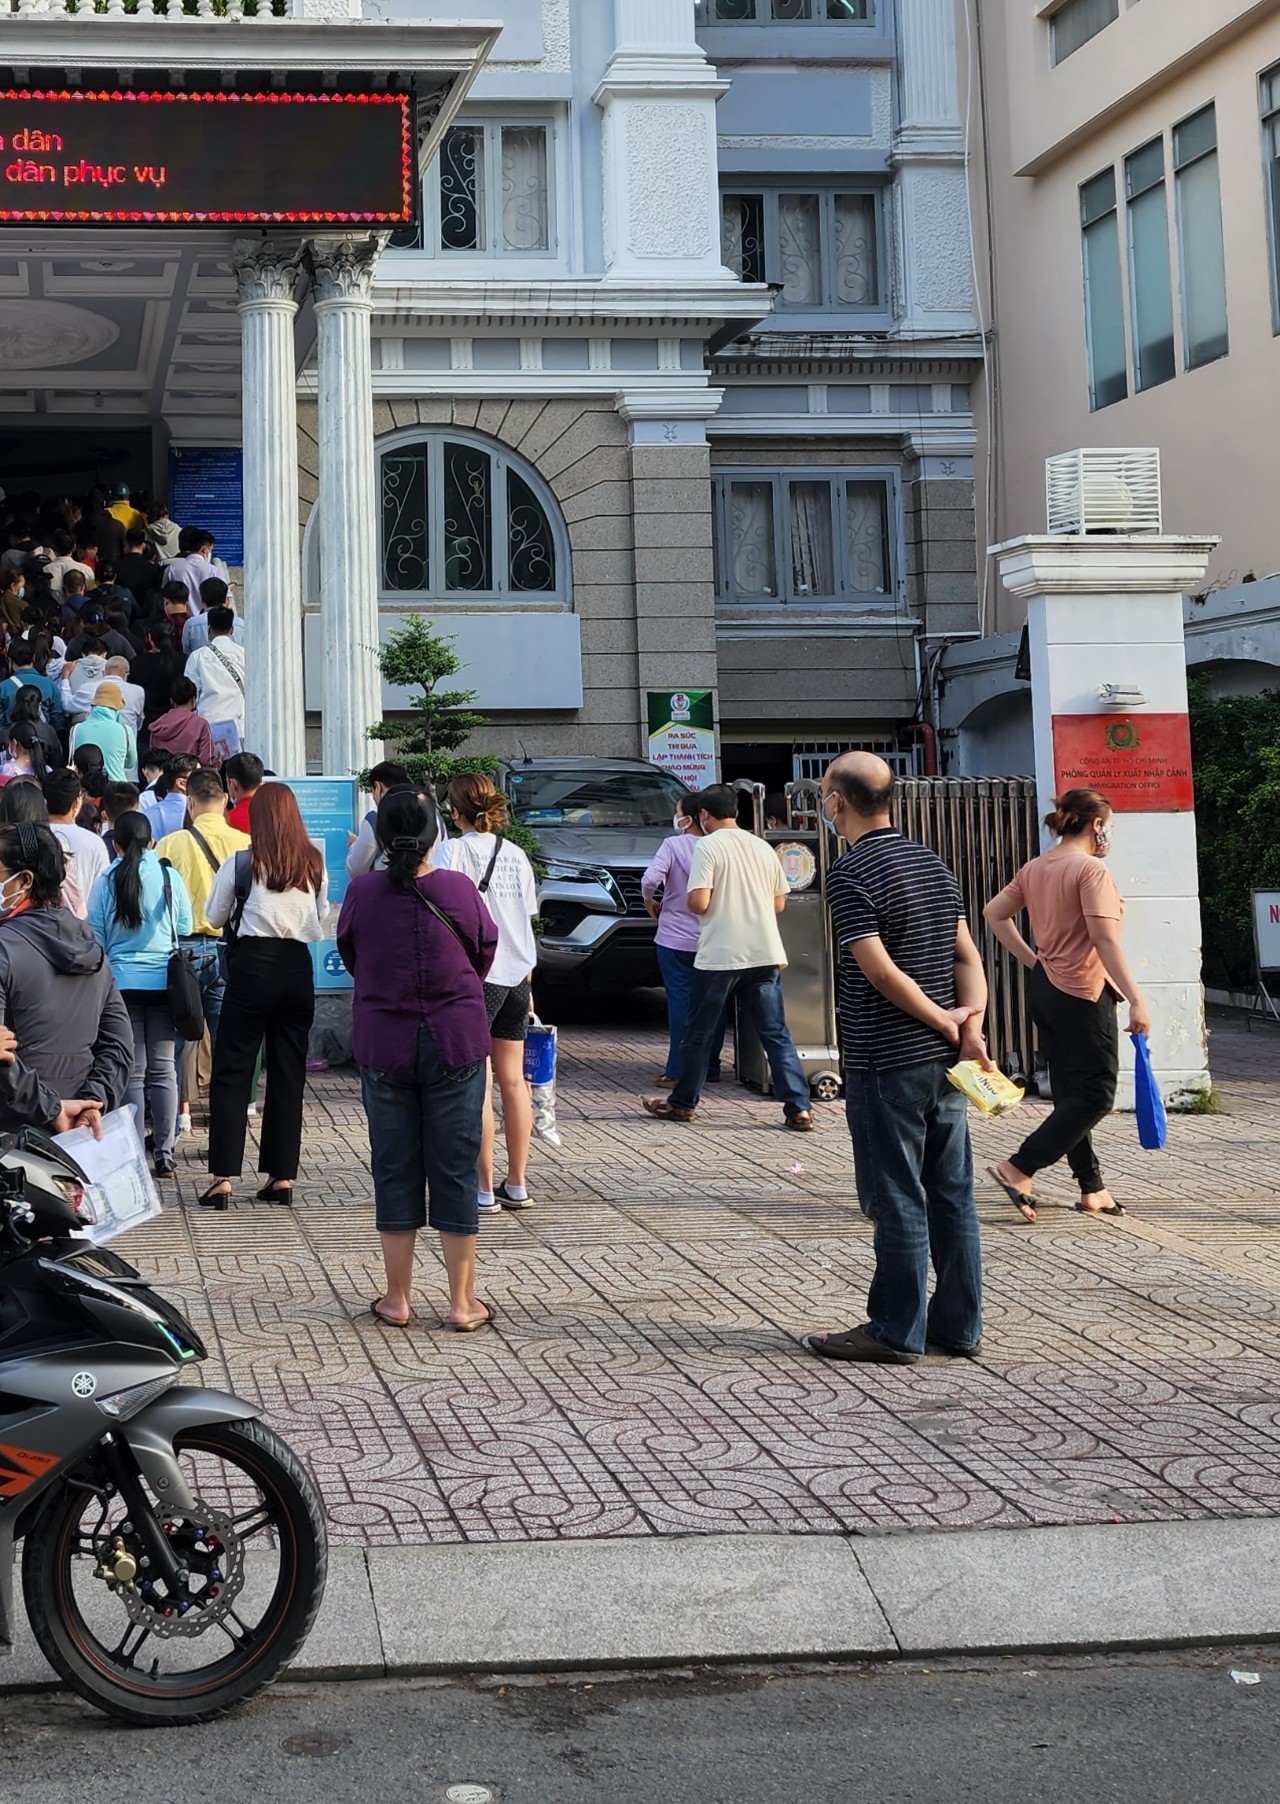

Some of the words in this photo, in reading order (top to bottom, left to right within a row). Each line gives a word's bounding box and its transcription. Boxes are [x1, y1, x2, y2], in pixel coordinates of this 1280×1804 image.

[12, 127, 62, 151] dân
[5, 158, 56, 183] dân
[63, 159, 127, 188] phục
[134, 164, 167, 189] vụ
[1269, 904, 1280, 924] N
